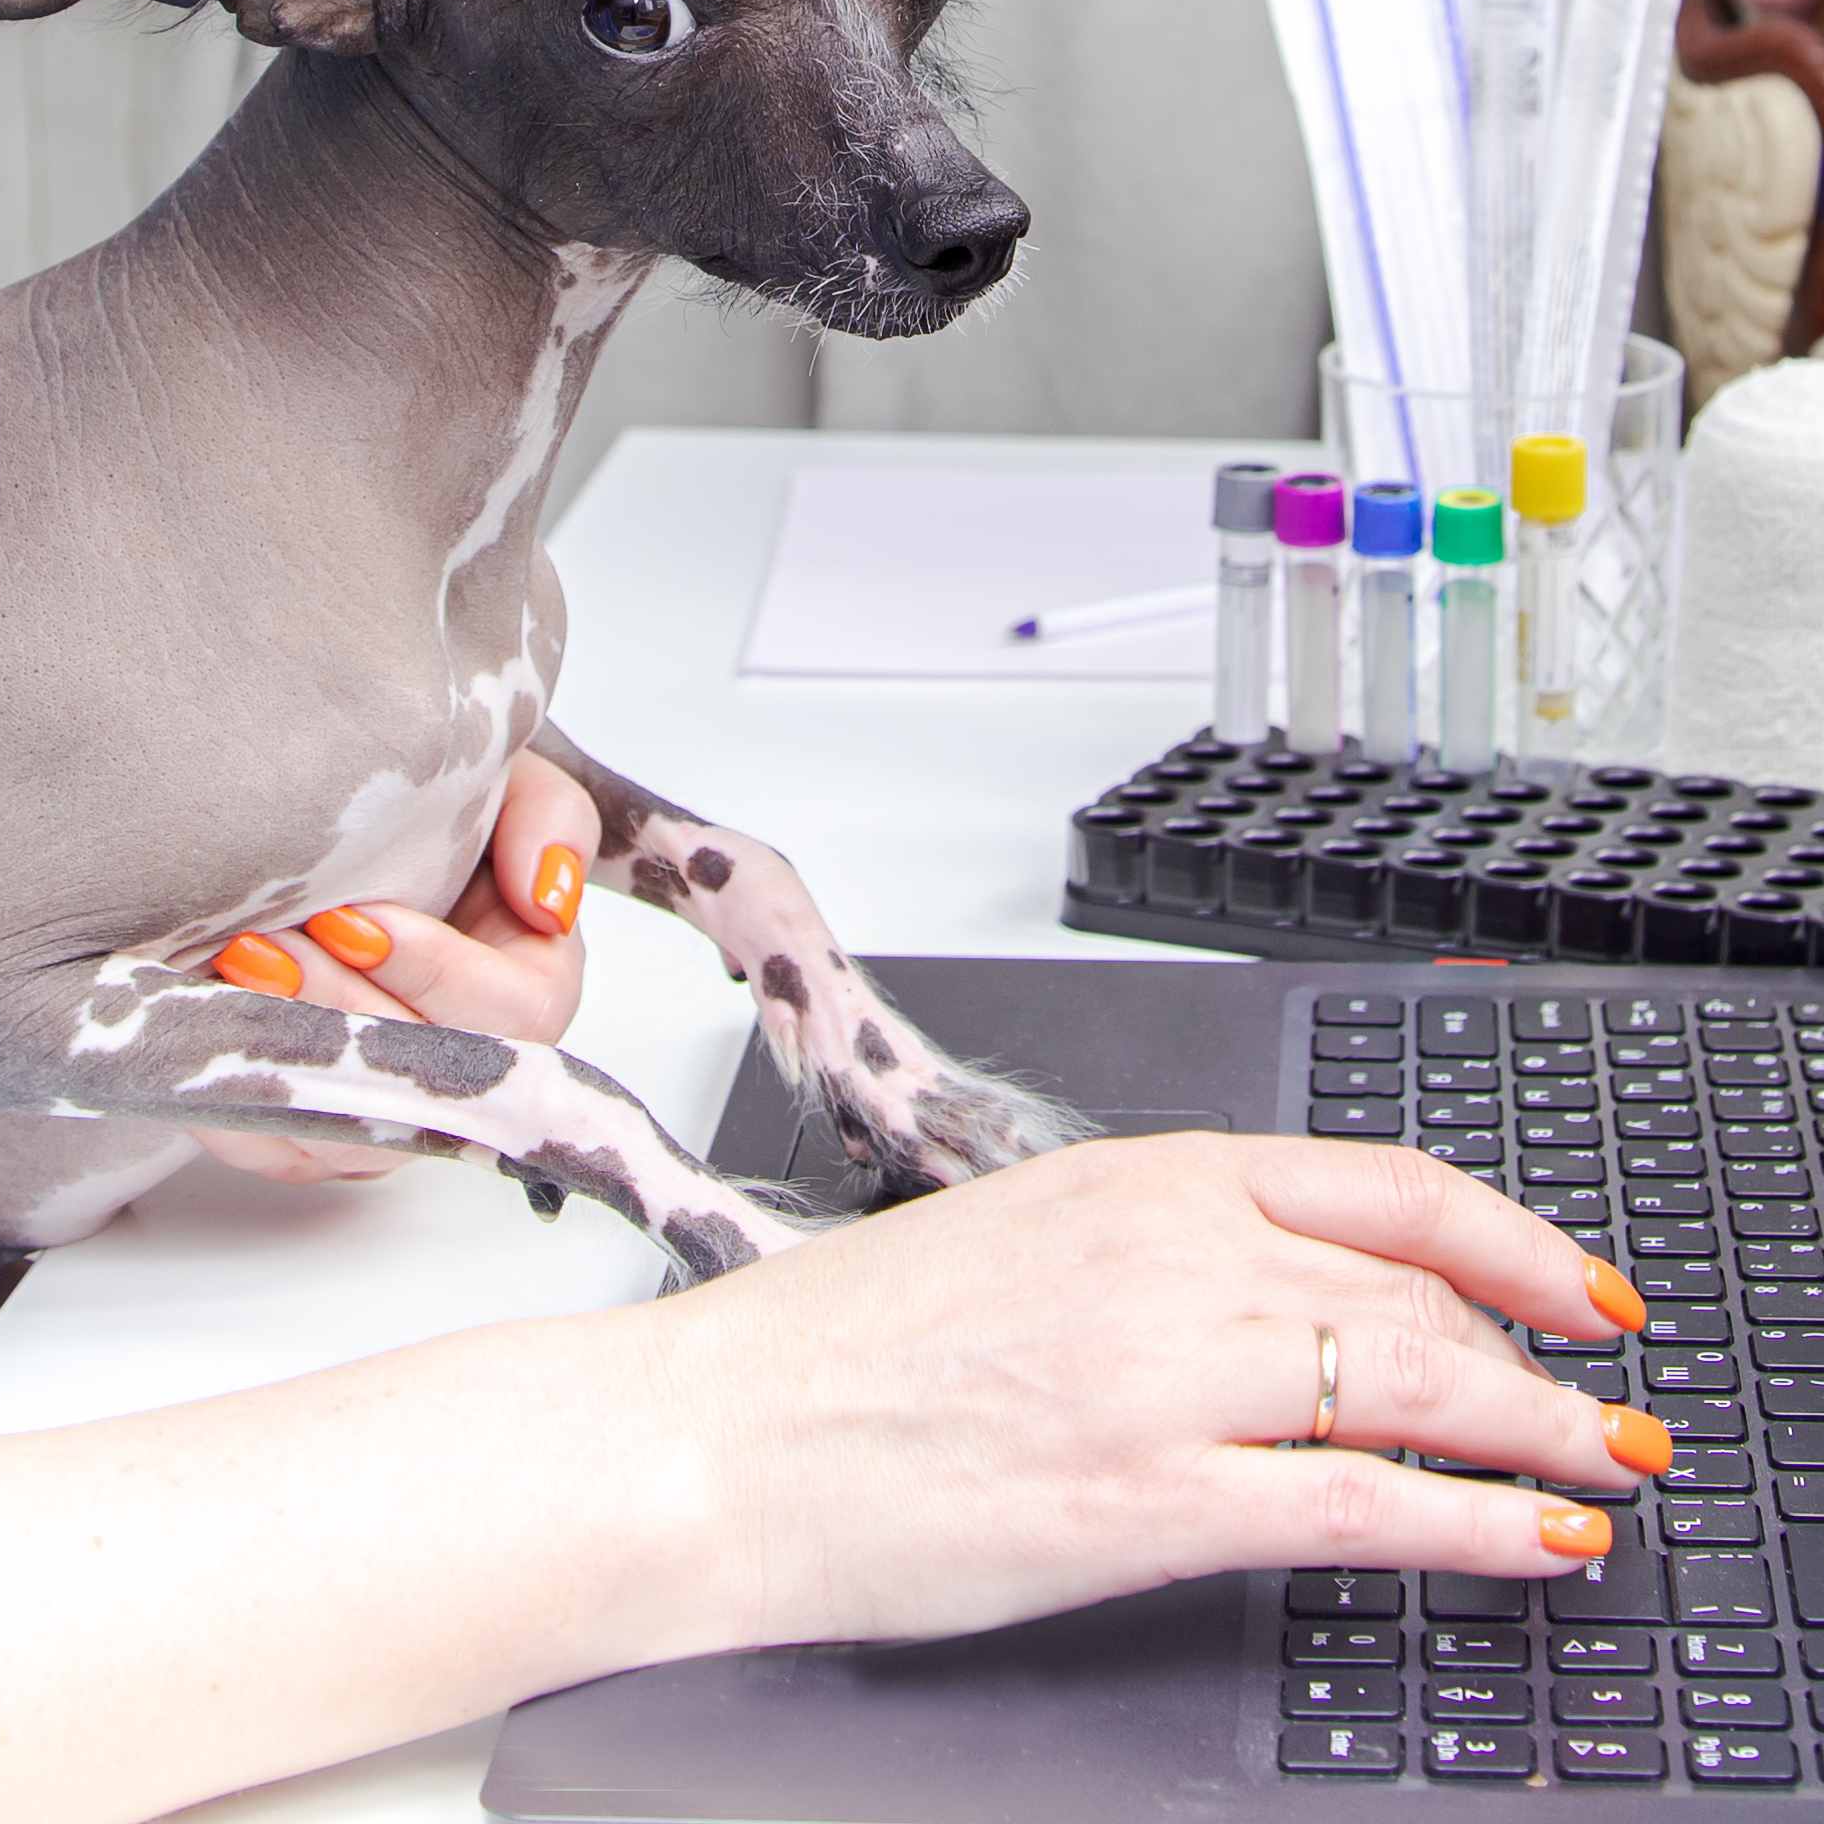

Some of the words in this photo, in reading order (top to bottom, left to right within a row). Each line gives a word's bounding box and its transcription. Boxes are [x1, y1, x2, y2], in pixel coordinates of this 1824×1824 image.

[1558, 1044, 1585, 1055] A
[1462, 1060, 1491, 1069] Z
[1559, 1078, 1588, 1086] S
[1719, 1088, 1744, 1097] 3
[1465, 1095, 1491, 1104] X
[1661, 1105, 1689, 1113] E
[1563, 1113, 1591, 1123] D
[1727, 1125, 1750, 1133] 4
[1465, 1131, 1493, 1140] C
[1667, 1142, 1694, 1151] R
[1731, 1163, 1757, 1171] 5
[1672, 1181, 1700, 1190] T
[1570, 1189, 1598, 1199] G
[1739, 1202, 1764, 1211] 6
[1678, 1221, 1705, 1230] Y
[1573, 1230, 1601, 1239] H
[1746, 1243, 1771, 1251] 7
[1683, 1262, 1712, 1271] U
[1753, 1285, 1778, 1294] 8
[1761, 1330, 1786, 1339] 9
[1696, 1351, 1724, 1362] O
[1586, 1361, 1614, 1369] L
[1769, 1377, 1794, 1386] 0
[1703, 1399, 1732, 1408] P
[1793, 1476, 1805, 1486] =
[1311, 1632, 1331, 1646] Ins
[1348, 1635, 1376, 1644] 0
[1436, 1634, 1458, 1652] End
[1590, 1641, 1618, 1651] 4
[1687, 1634, 1707, 1661] Home
[1716, 1643, 1745, 1653] 7
[1309, 1682, 1332, 1700] Del
[1464, 1689, 1494, 1700] 2
[1592, 1690, 1622, 1701] 5
[1722, 1694, 1752, 1705] 8
[1330, 1730, 1354, 1757] Enter
[1431, 1731, 1460, 1746] Pg
[1465, 1740, 1497, 1752] 3
[1596, 1743, 1628, 1755] 6
[1692, 1736, 1722, 1752] Pg
[1436, 1746, 1460, 1761] Dn
[1728, 1746, 1759, 1759] 9
[1695, 1753, 1722, 1767] Up
